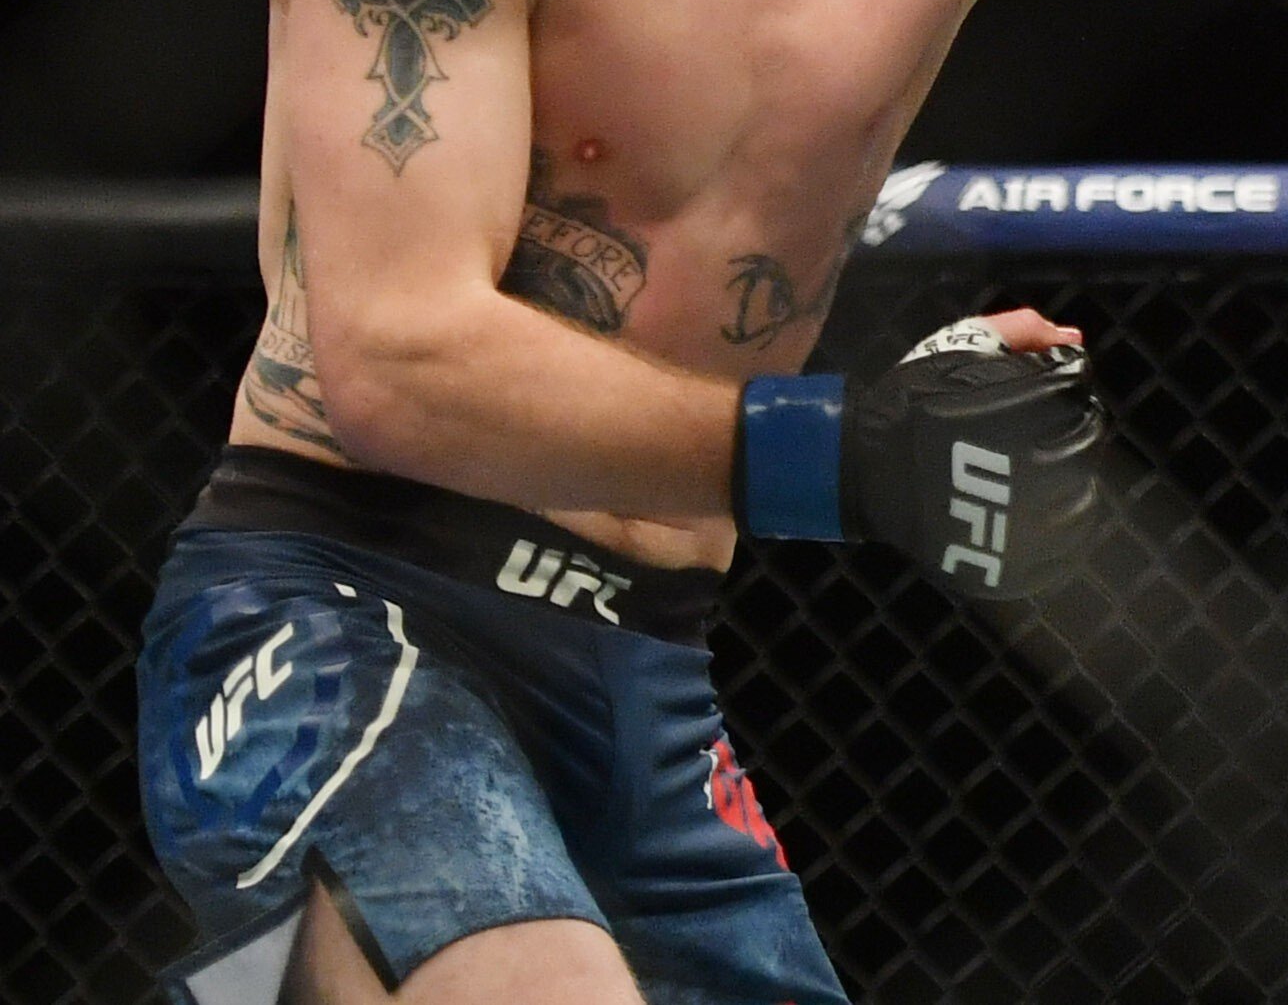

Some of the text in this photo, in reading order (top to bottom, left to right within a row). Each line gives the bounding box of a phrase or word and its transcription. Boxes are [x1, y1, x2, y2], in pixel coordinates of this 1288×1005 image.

[957, 175, 1070, 212] AIR
[1075, 174, 1278, 213] FORCE
[524, 214, 641, 292] EFORE
[941, 441, 1011, 587] UFC
[496, 538, 632, 625] UFC
[195, 622, 294, 780] UFC
